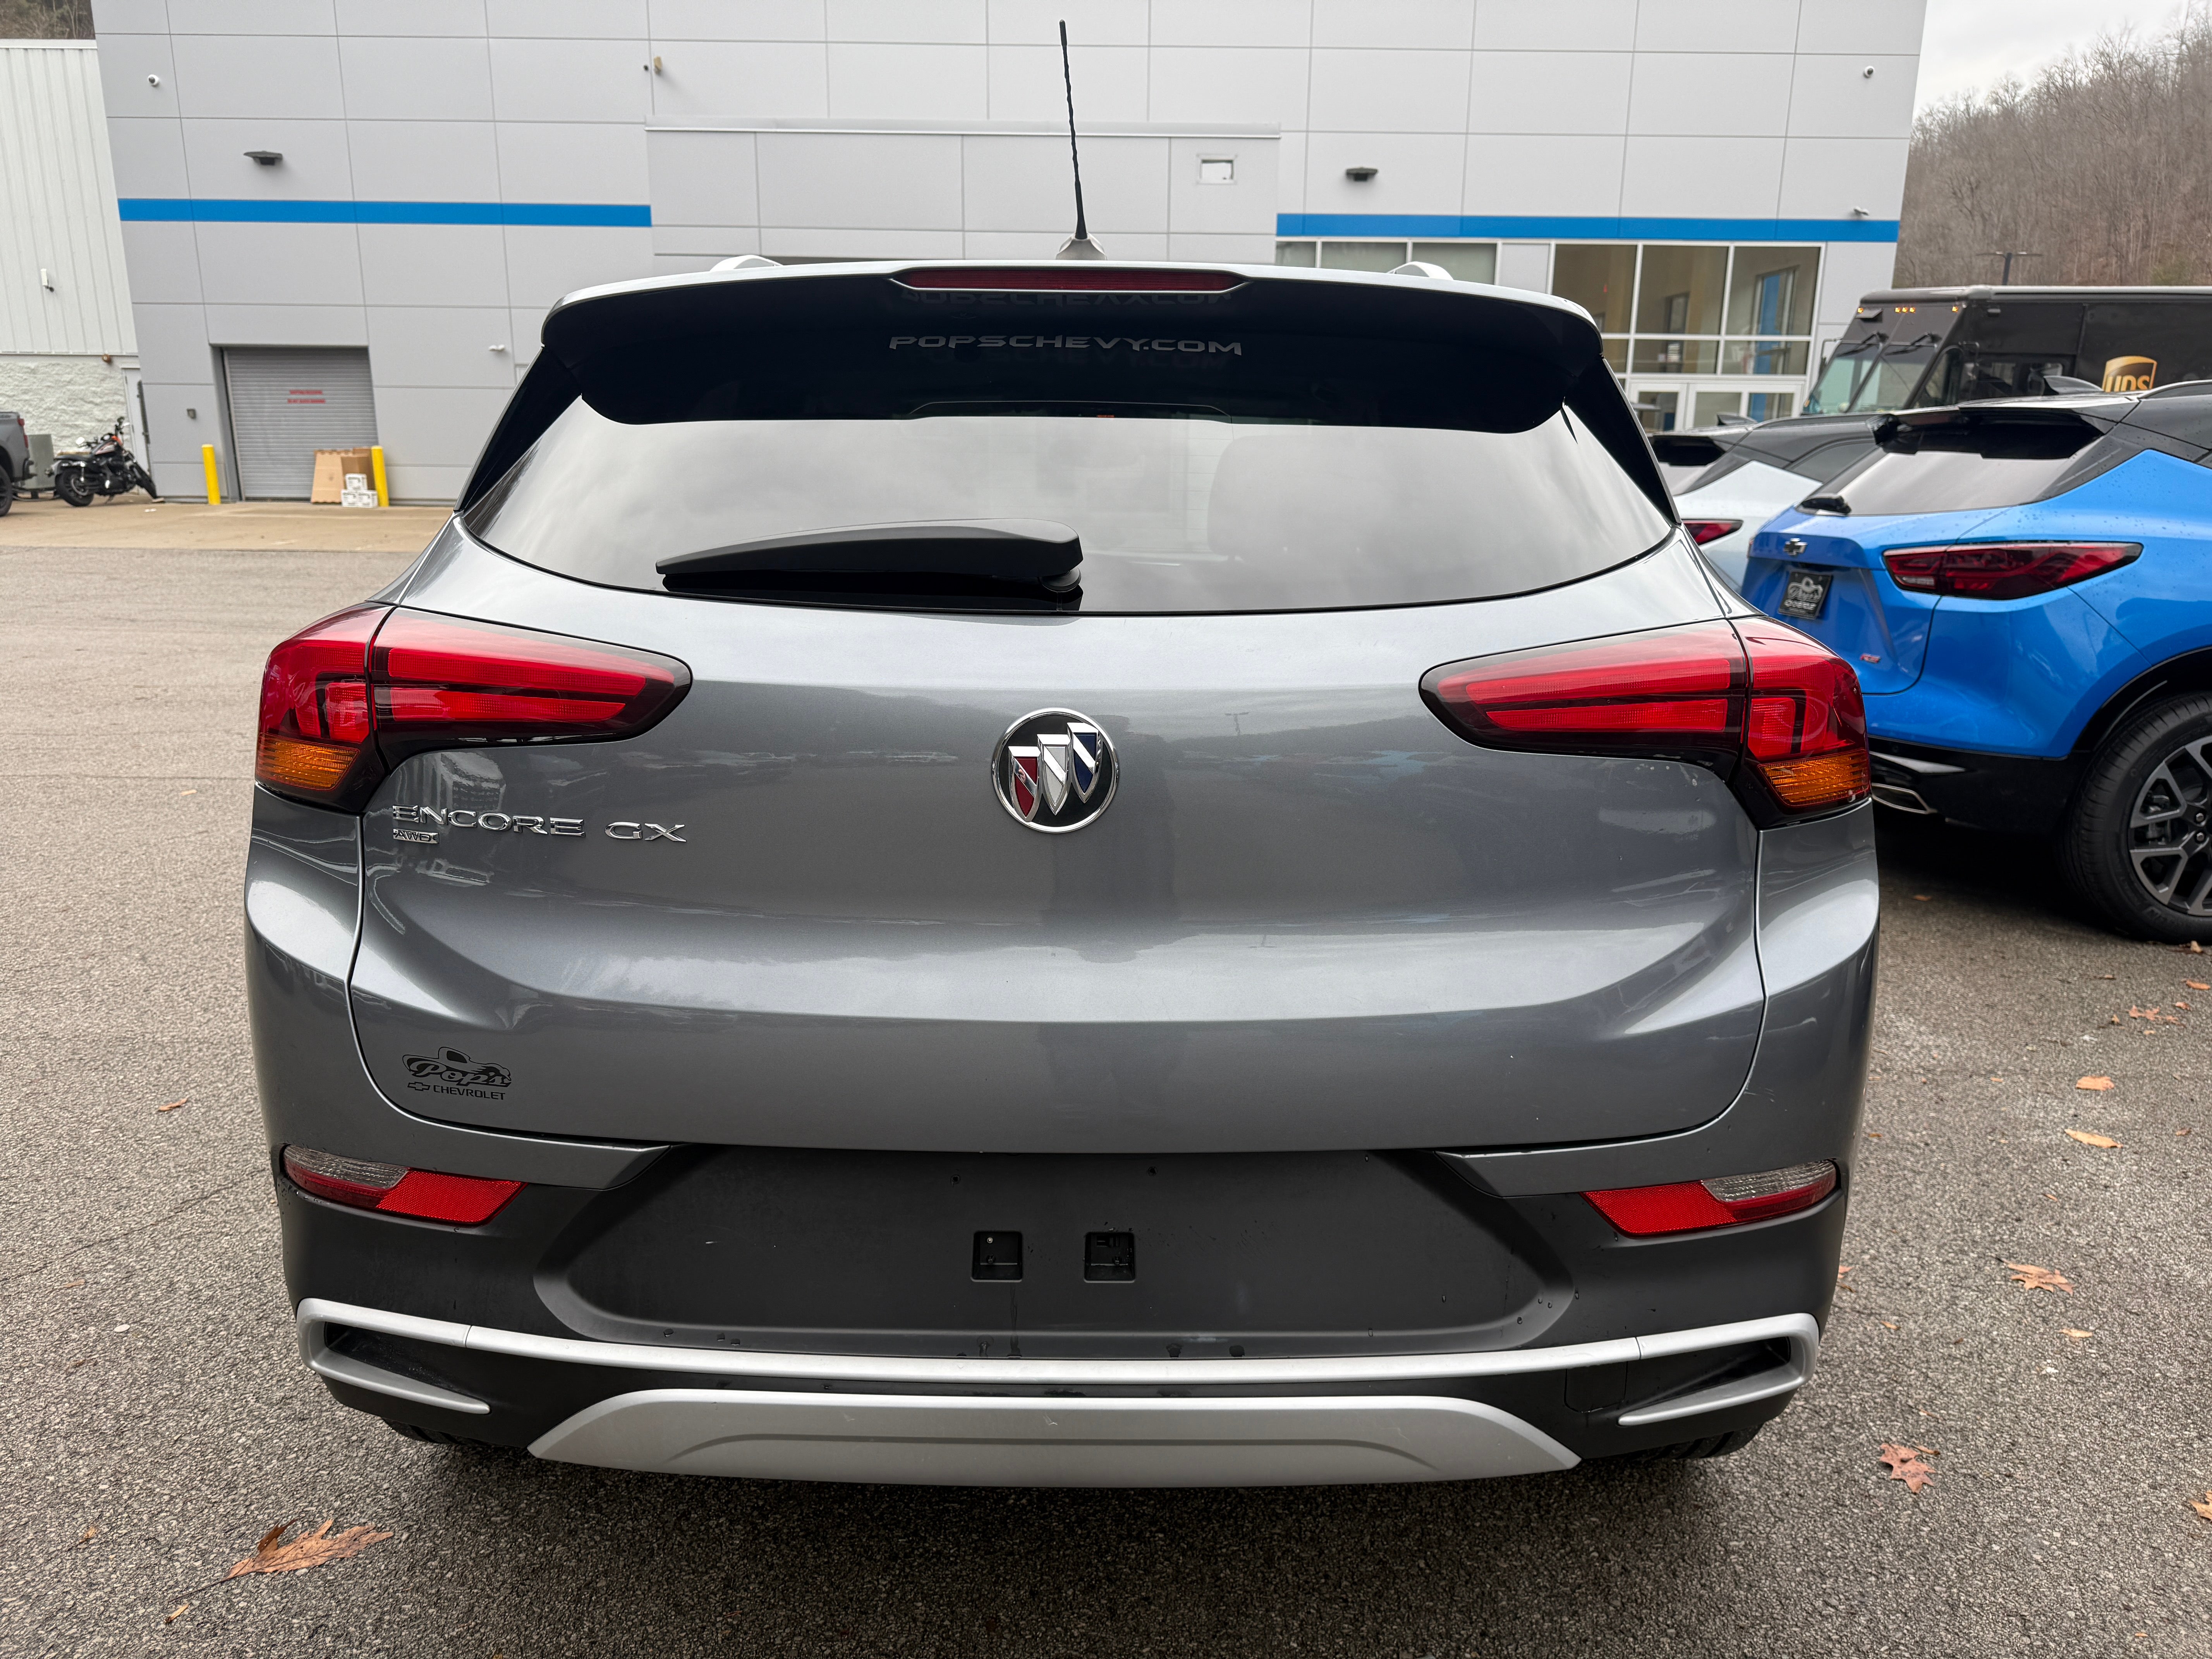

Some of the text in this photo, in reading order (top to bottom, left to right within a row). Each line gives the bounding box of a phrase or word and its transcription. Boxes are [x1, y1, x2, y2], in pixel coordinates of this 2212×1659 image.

[889, 335, 1242, 356] POPSCHEVY.COM
[392, 805, 687, 842] ENCORE GX
[395, 830, 432, 842] AWD
[409, 1060, 511, 1087] Pops
[433, 1085, 506, 1100] CHEVROLET
